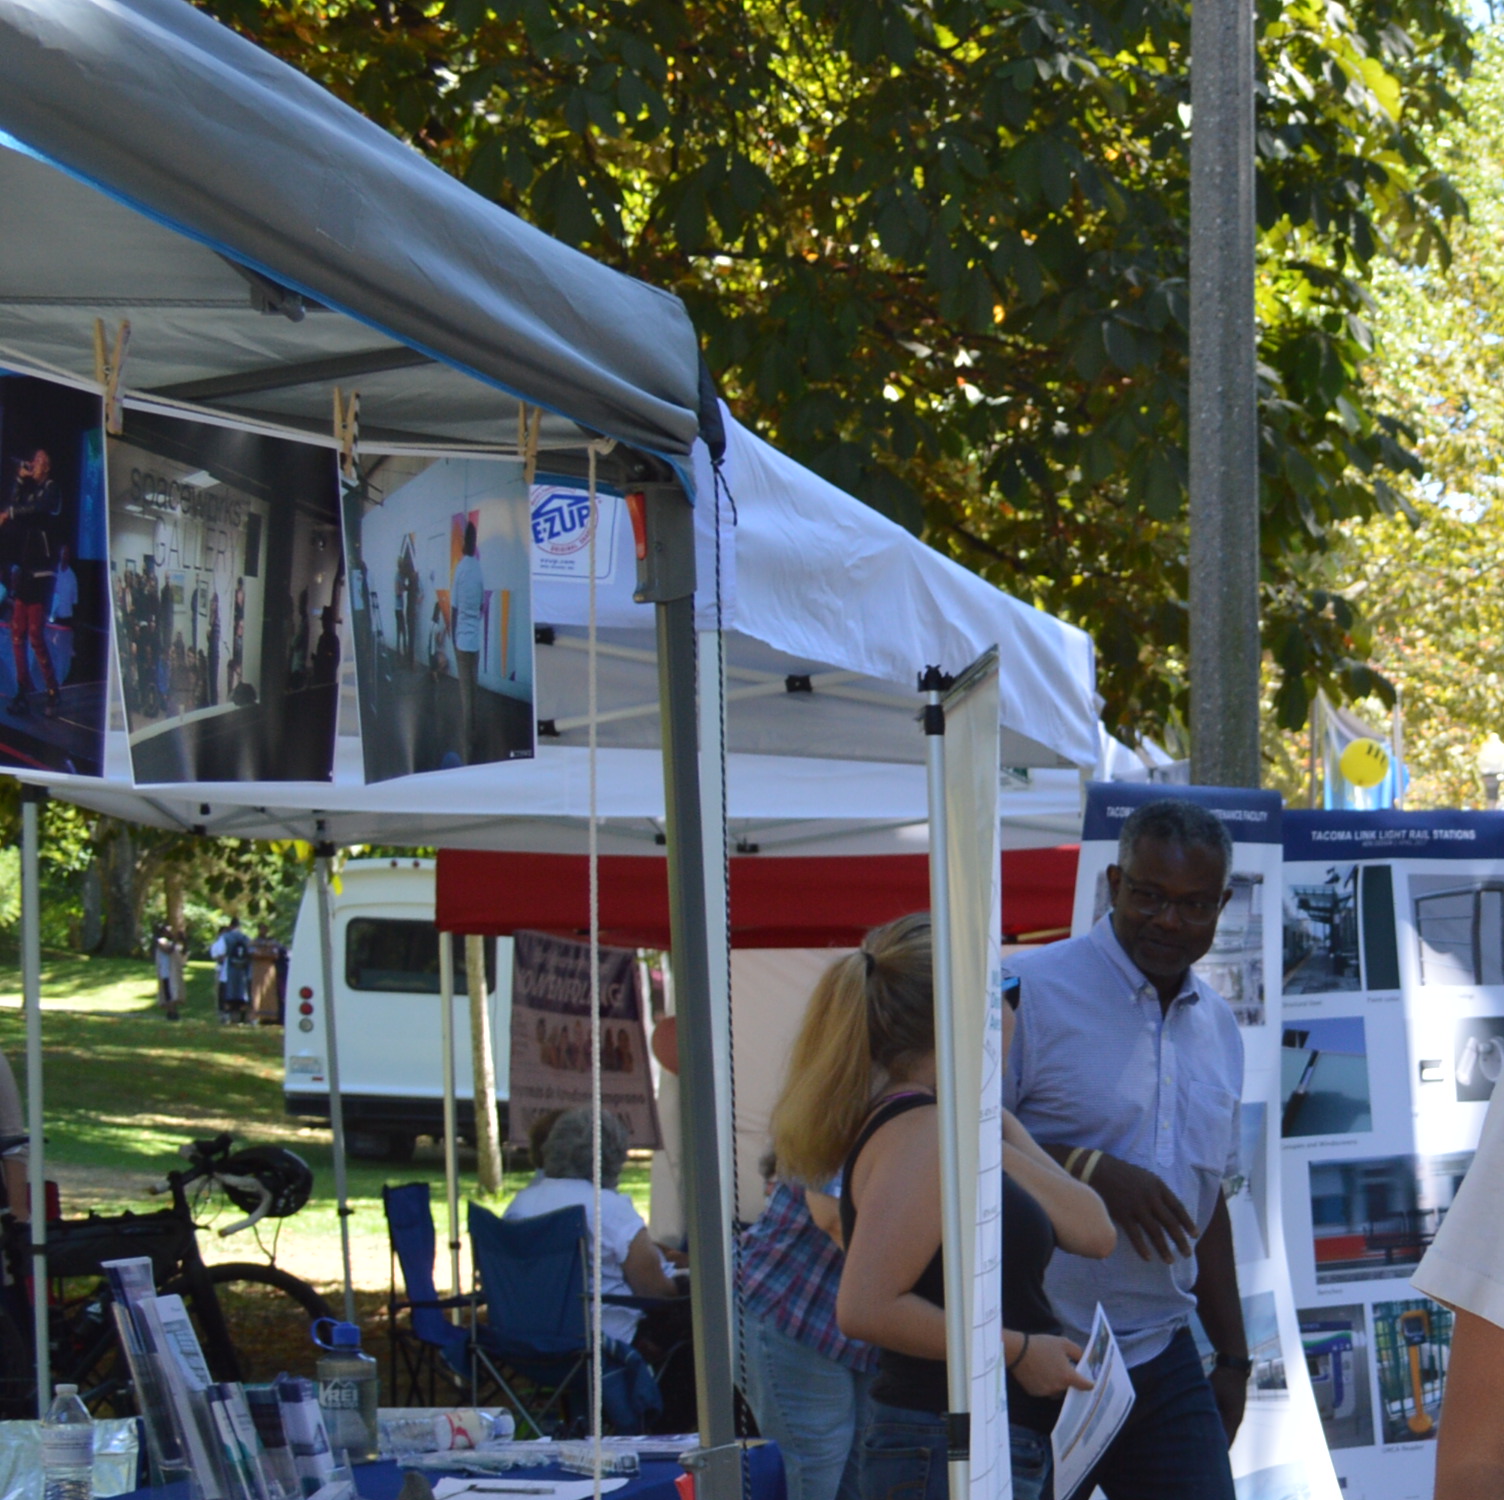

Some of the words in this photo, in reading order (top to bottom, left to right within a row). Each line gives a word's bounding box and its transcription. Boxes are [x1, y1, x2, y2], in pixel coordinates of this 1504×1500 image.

[1311, 831, 1352, 841] TACOMA
[1354, 831, 1377, 840] LINK
[1379, 830, 1407, 840] LIGHT
[1409, 829, 1430, 840] RAIL
[1432, 829, 1476, 840] STATIONS
